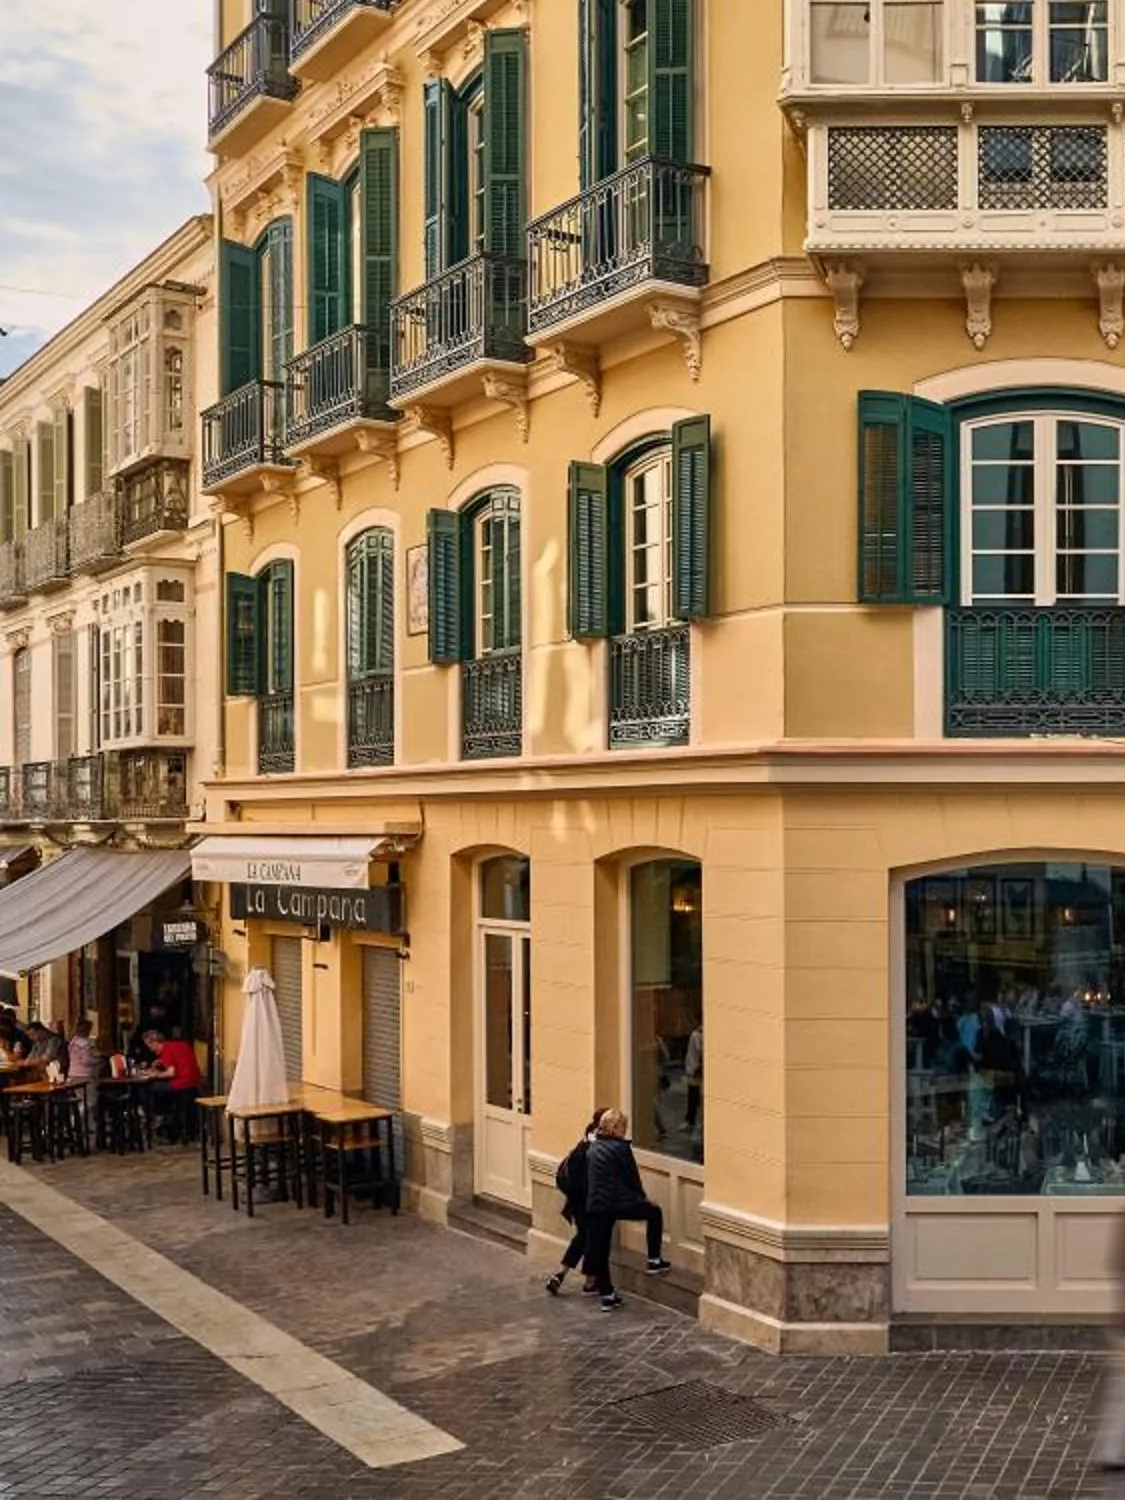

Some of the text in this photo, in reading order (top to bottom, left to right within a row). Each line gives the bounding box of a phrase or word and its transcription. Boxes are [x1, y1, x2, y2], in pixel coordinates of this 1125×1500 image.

[247, 862, 302, 882] LA CAMPANA
[246, 884, 367, 924] La Campana
